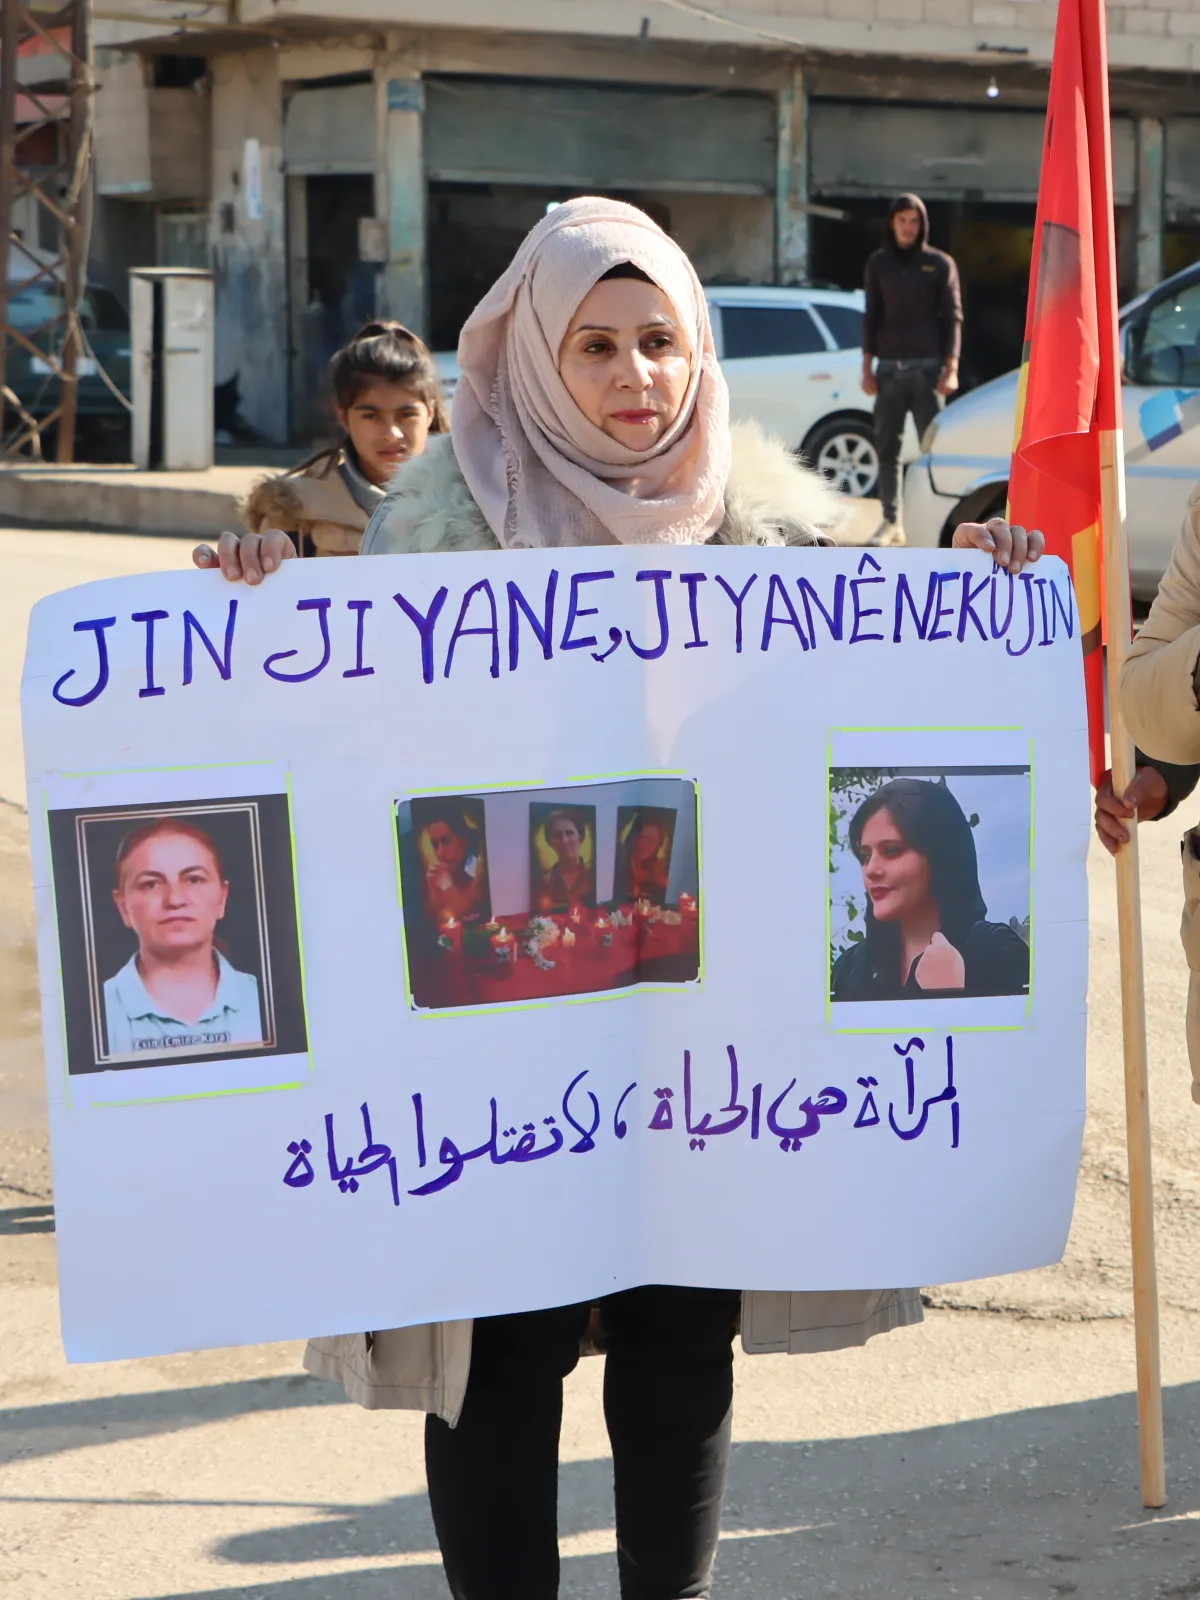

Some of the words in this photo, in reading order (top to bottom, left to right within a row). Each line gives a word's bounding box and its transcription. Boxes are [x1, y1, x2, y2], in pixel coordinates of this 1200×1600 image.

[52, 599, 238, 707] JIN
[282, 1101, 400, 1207] الحياة
[766, 1077, 848, 1153] هي
